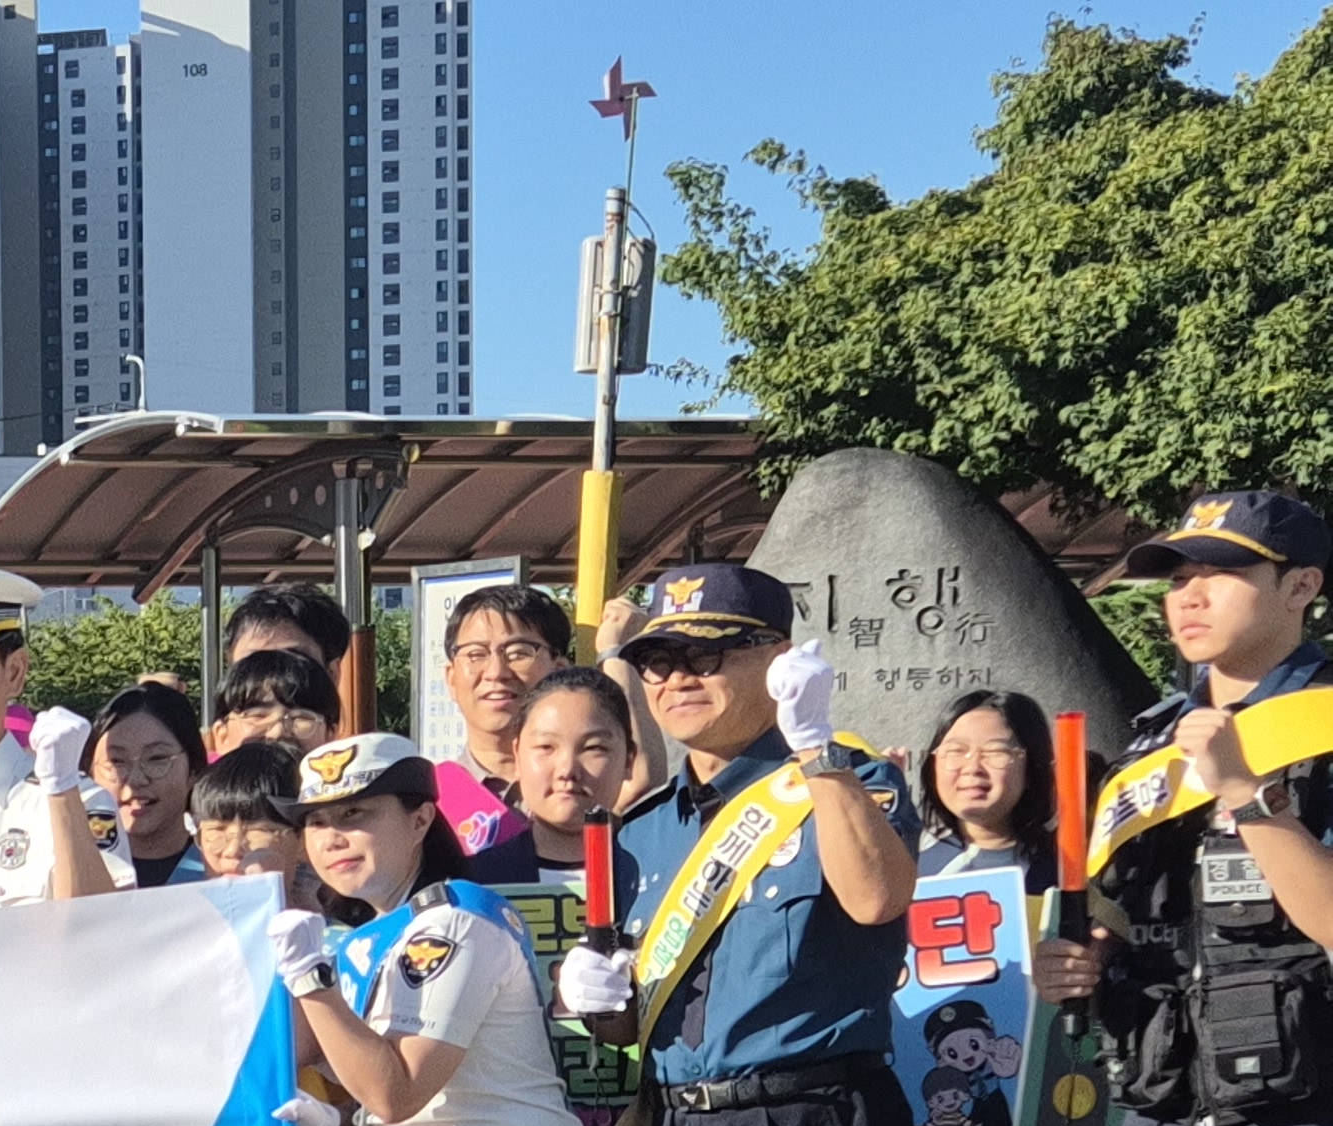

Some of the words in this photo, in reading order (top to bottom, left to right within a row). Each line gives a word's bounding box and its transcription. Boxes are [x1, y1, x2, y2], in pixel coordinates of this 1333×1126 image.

[182, 63, 208, 78] 108
[848, 615, 886, 650] 智
[885, 565, 961, 637] 행
[953, 610, 998, 647] 行
[874, 665, 992, 691] 행동하지
[683, 806, 773, 919] 함께하는
[1210, 883, 1264, 895] POLICE
[907, 890, 1003, 987] 단
